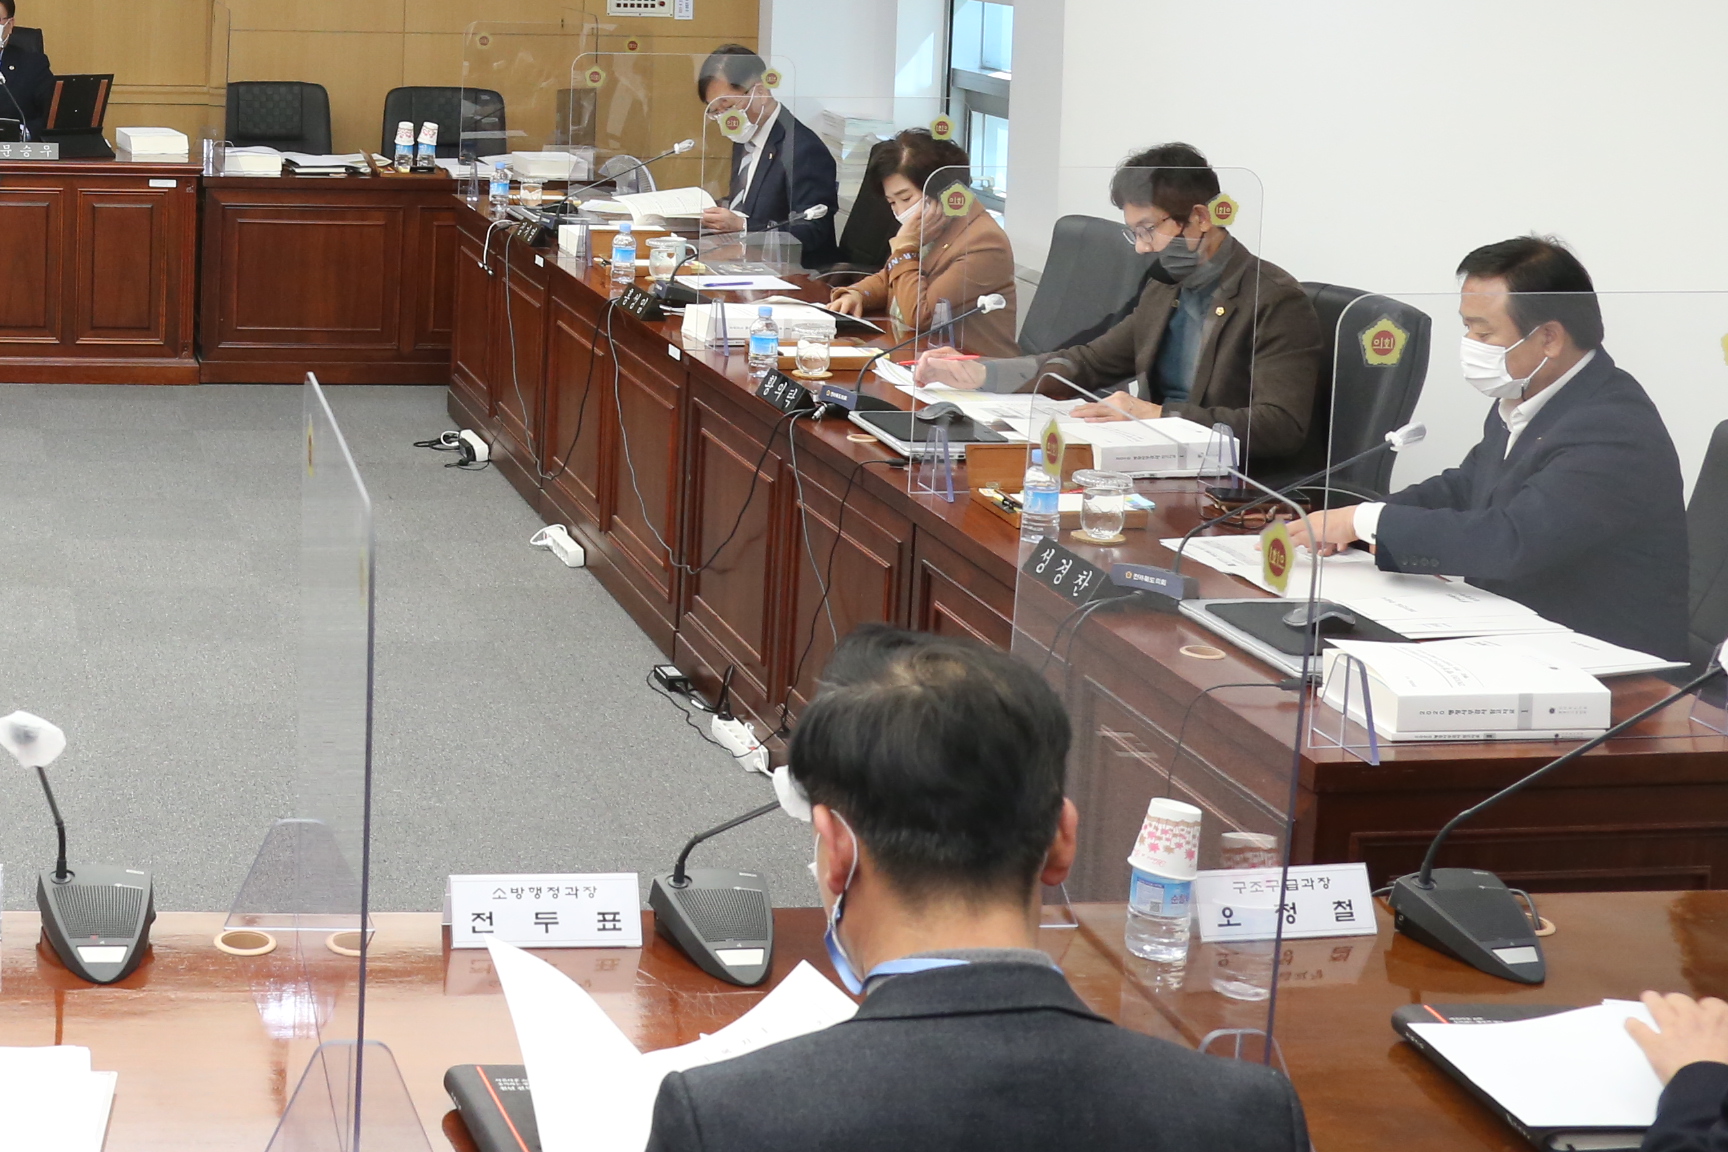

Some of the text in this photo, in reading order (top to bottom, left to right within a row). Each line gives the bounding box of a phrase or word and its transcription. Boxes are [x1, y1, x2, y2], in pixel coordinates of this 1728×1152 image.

[0, 144, 52, 158] 문승우
[1035, 547, 1098, 598] 성경찬
[492, 885, 598, 900] 소방행정과장
[1232, 876, 1331, 895] 구조구급과장
[471, 911, 623, 934] 전두표
